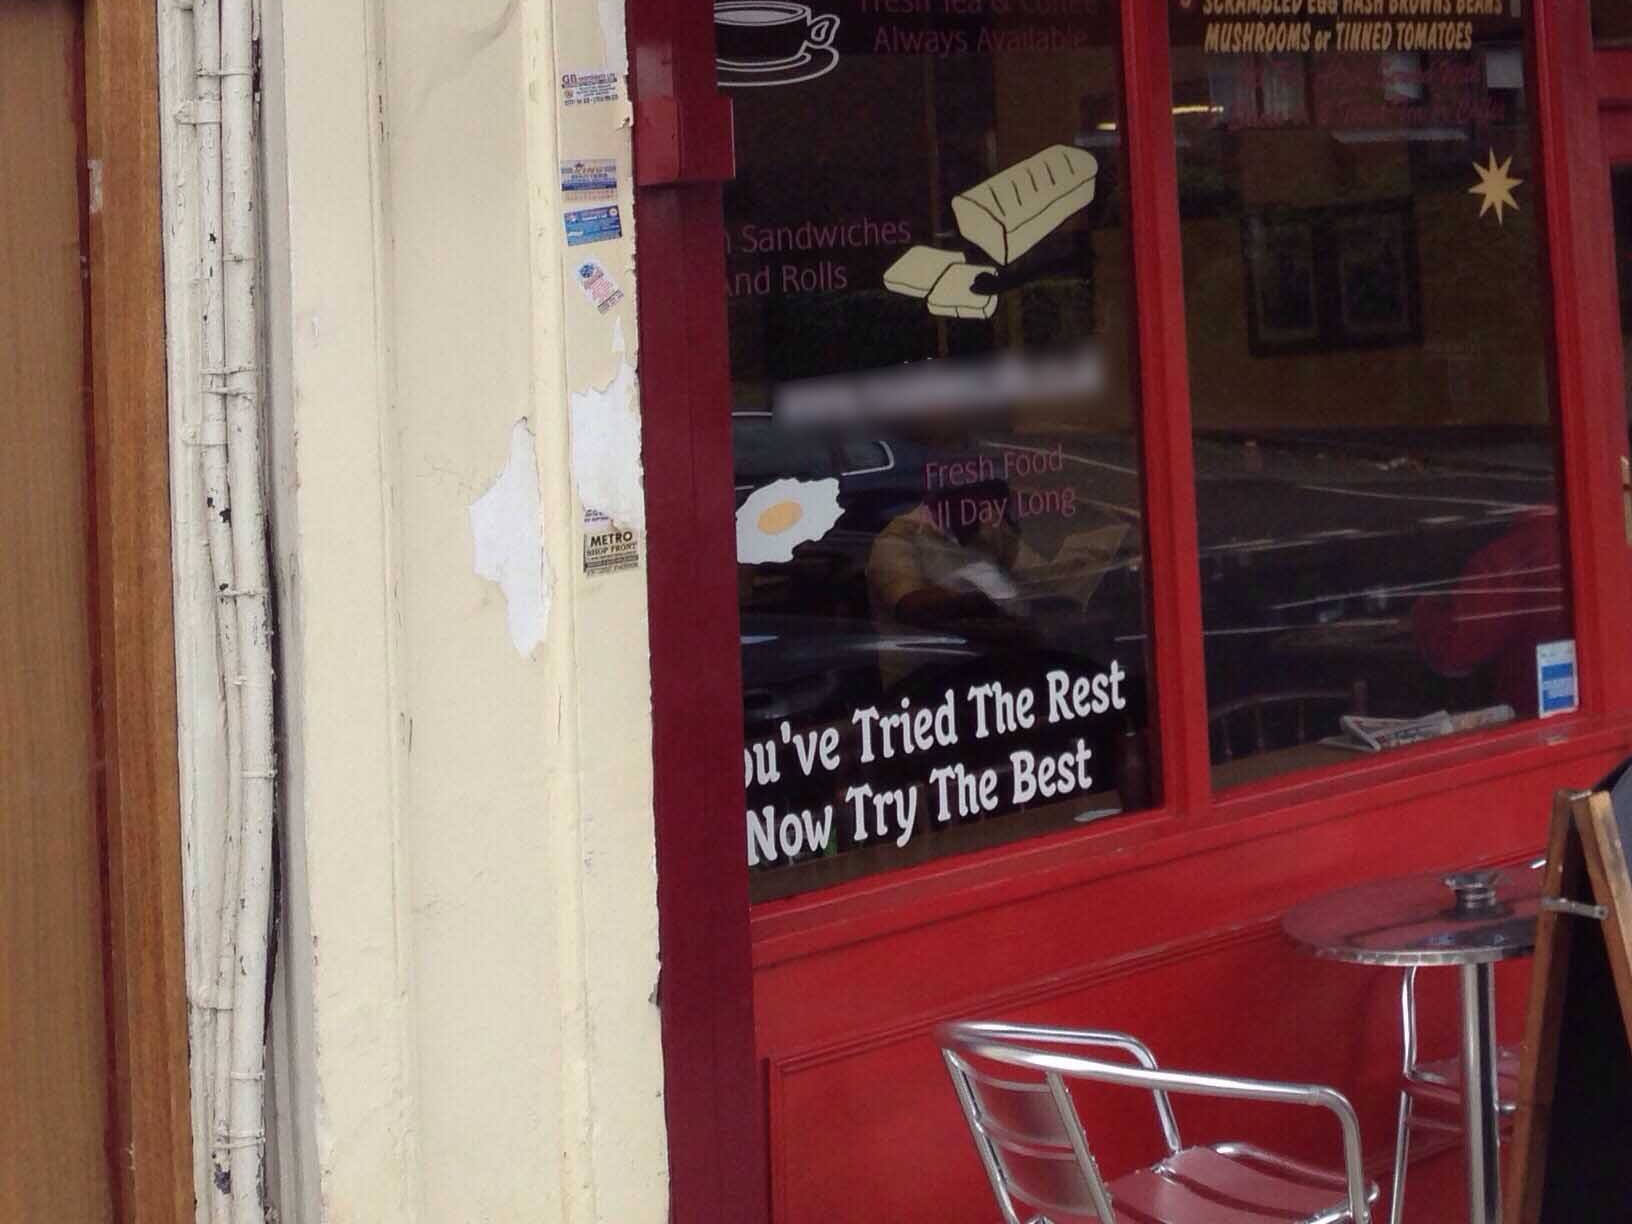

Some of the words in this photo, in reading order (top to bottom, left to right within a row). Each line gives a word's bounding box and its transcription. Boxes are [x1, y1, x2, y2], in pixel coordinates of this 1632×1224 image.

[1204, 21, 1311, 53] MUSHROOMS
[1314, 30, 1332, 52] or
[1336, 22, 1392, 51] TINNED
[1397, 21, 1472, 52] TOMATOES
[742, 216, 912, 255] Sandwiches
[782, 260, 848, 291] Rolls
[925, 453, 996, 490] Fresh
[1001, 443, 1064, 478] Food
[958, 496, 1007, 530] Day
[1015, 484, 1078, 520] Long
[590, 530, 634, 548] METRO
[851, 687, 960, 765] Tried
[967, 680, 1036, 739] The
[1045, 659, 1128, 724] Rest
[745, 804, 834, 868] Now
[845, 780, 918, 849] Try
[928, 761, 1000, 823] The
[1009, 737, 1094, 805] Best
